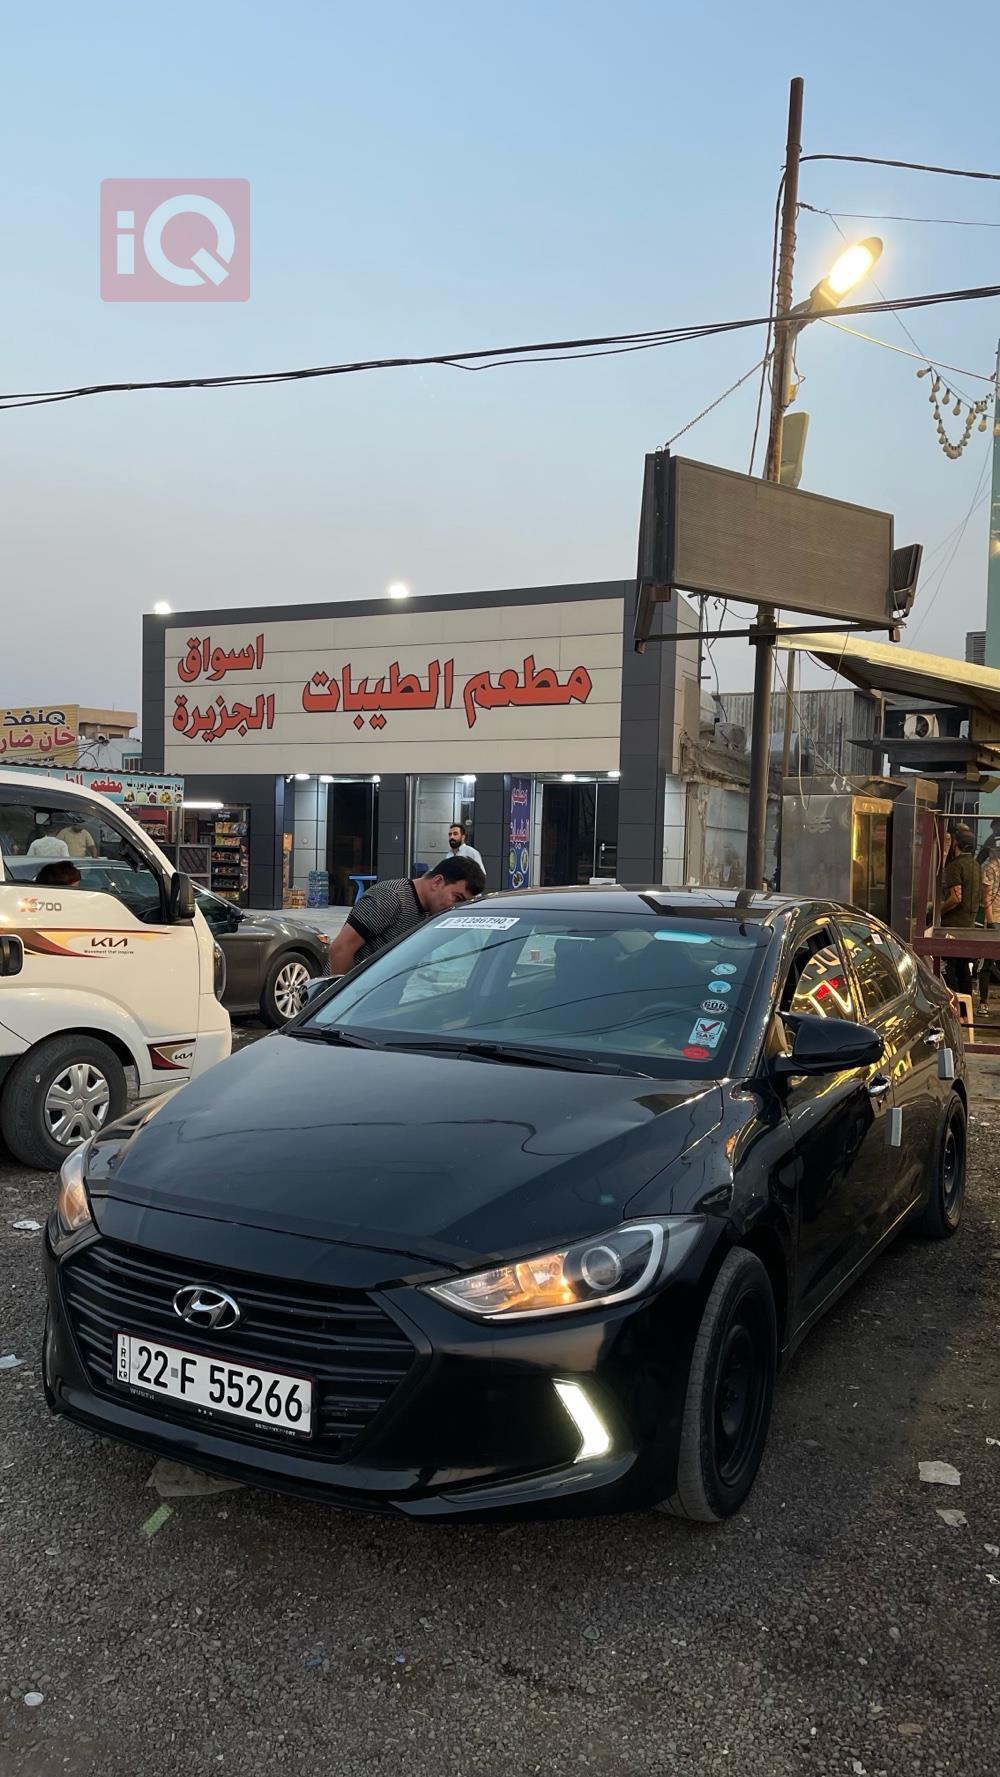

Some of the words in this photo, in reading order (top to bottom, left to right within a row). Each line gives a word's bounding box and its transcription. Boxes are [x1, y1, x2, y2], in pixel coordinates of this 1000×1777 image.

[177, 632, 265, 683] اسواق
[302, 657, 454, 730] الطيبات
[463, 654, 593, 728] مطعم
[39, 726, 76, 752] خان
[172, 692, 275, 743] الجزيرة
[91, 937, 128, 948] KIA
[174, 1052, 193, 1060] KIA
[118, 1369, 129, 1380] KR
[137, 1345, 169, 1389] 22
[180, 1356, 198, 1394] F
[208, 1364, 303, 1423] 55266
